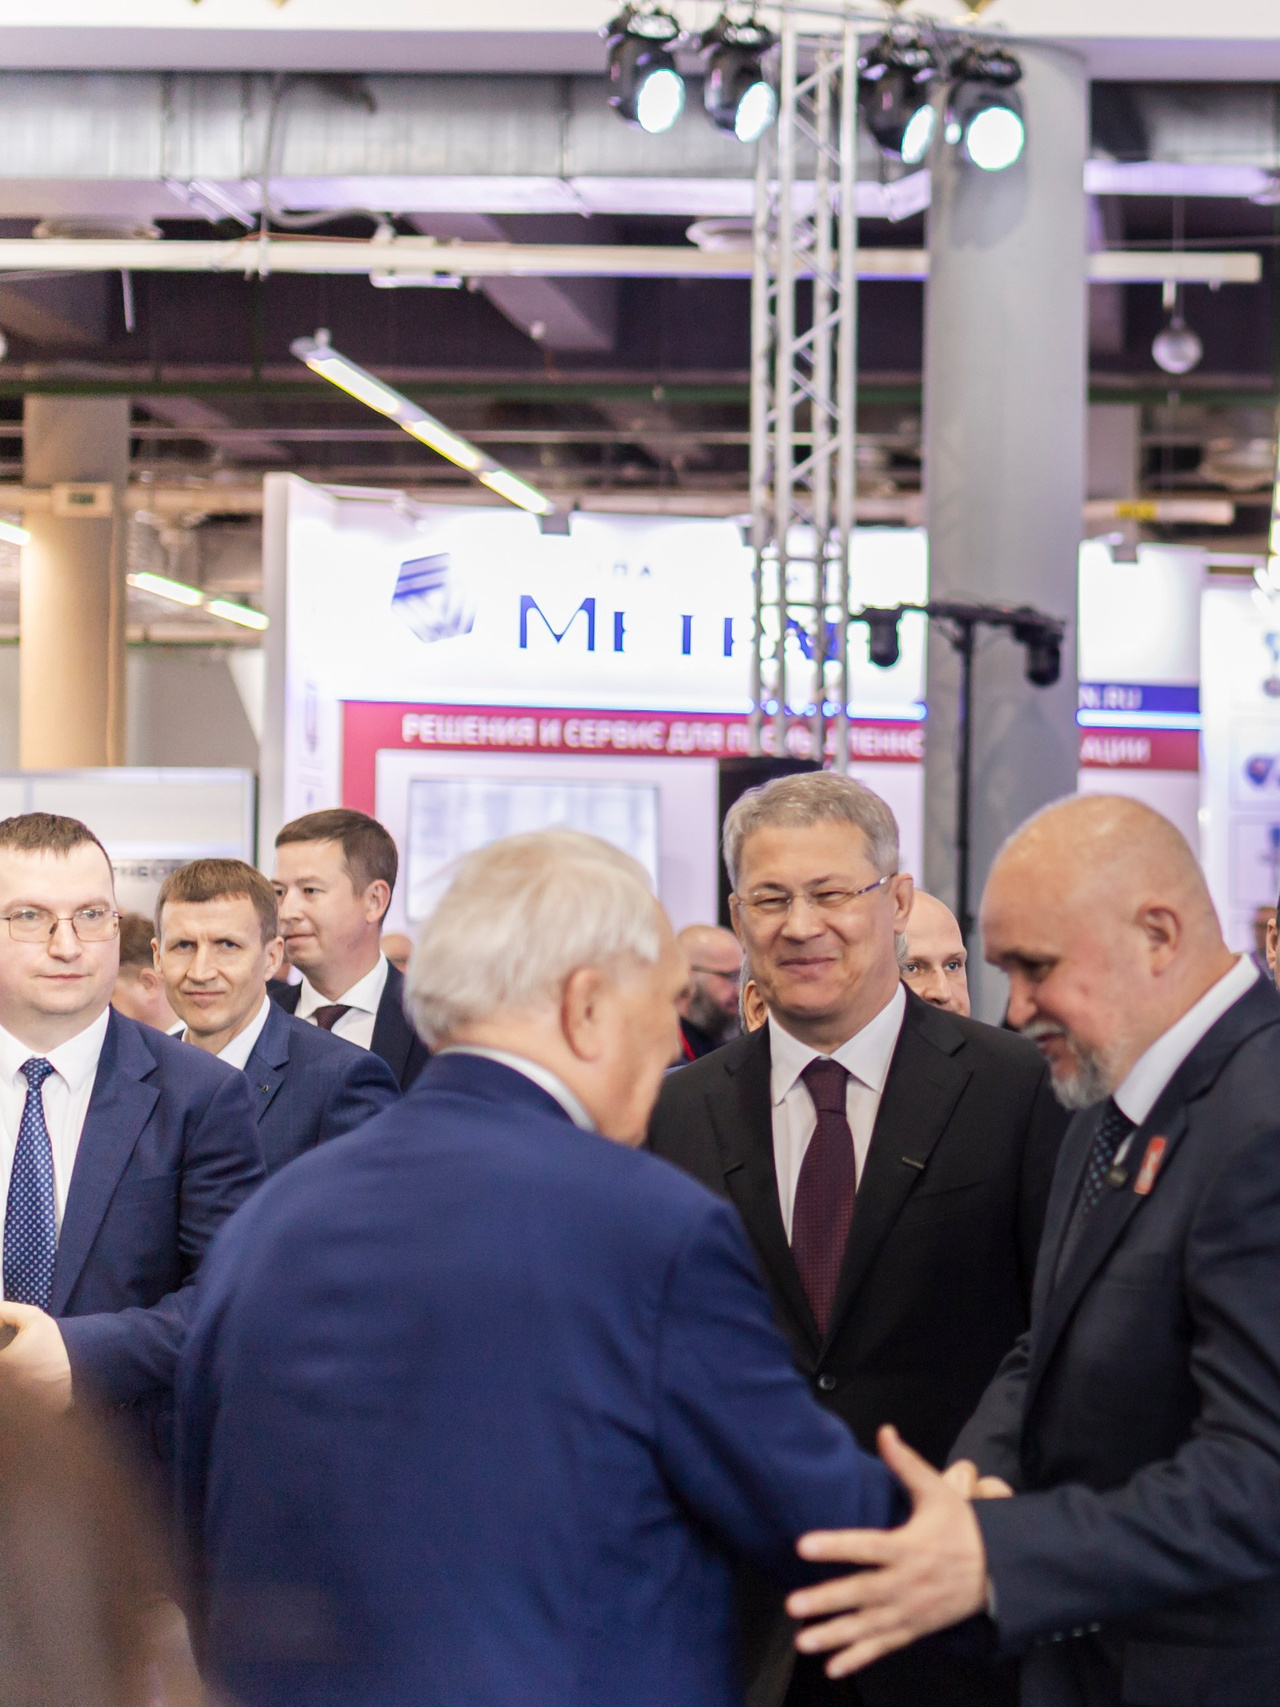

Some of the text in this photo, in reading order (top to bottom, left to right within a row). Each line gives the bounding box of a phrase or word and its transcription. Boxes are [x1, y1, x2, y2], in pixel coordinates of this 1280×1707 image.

[402, 713, 537, 745] РЕШЕНИЯ
[539, 717, 562, 747] И
[563, 718, 667, 750] СЕРВИС
[667, 721, 724, 754] ДЛЯ
